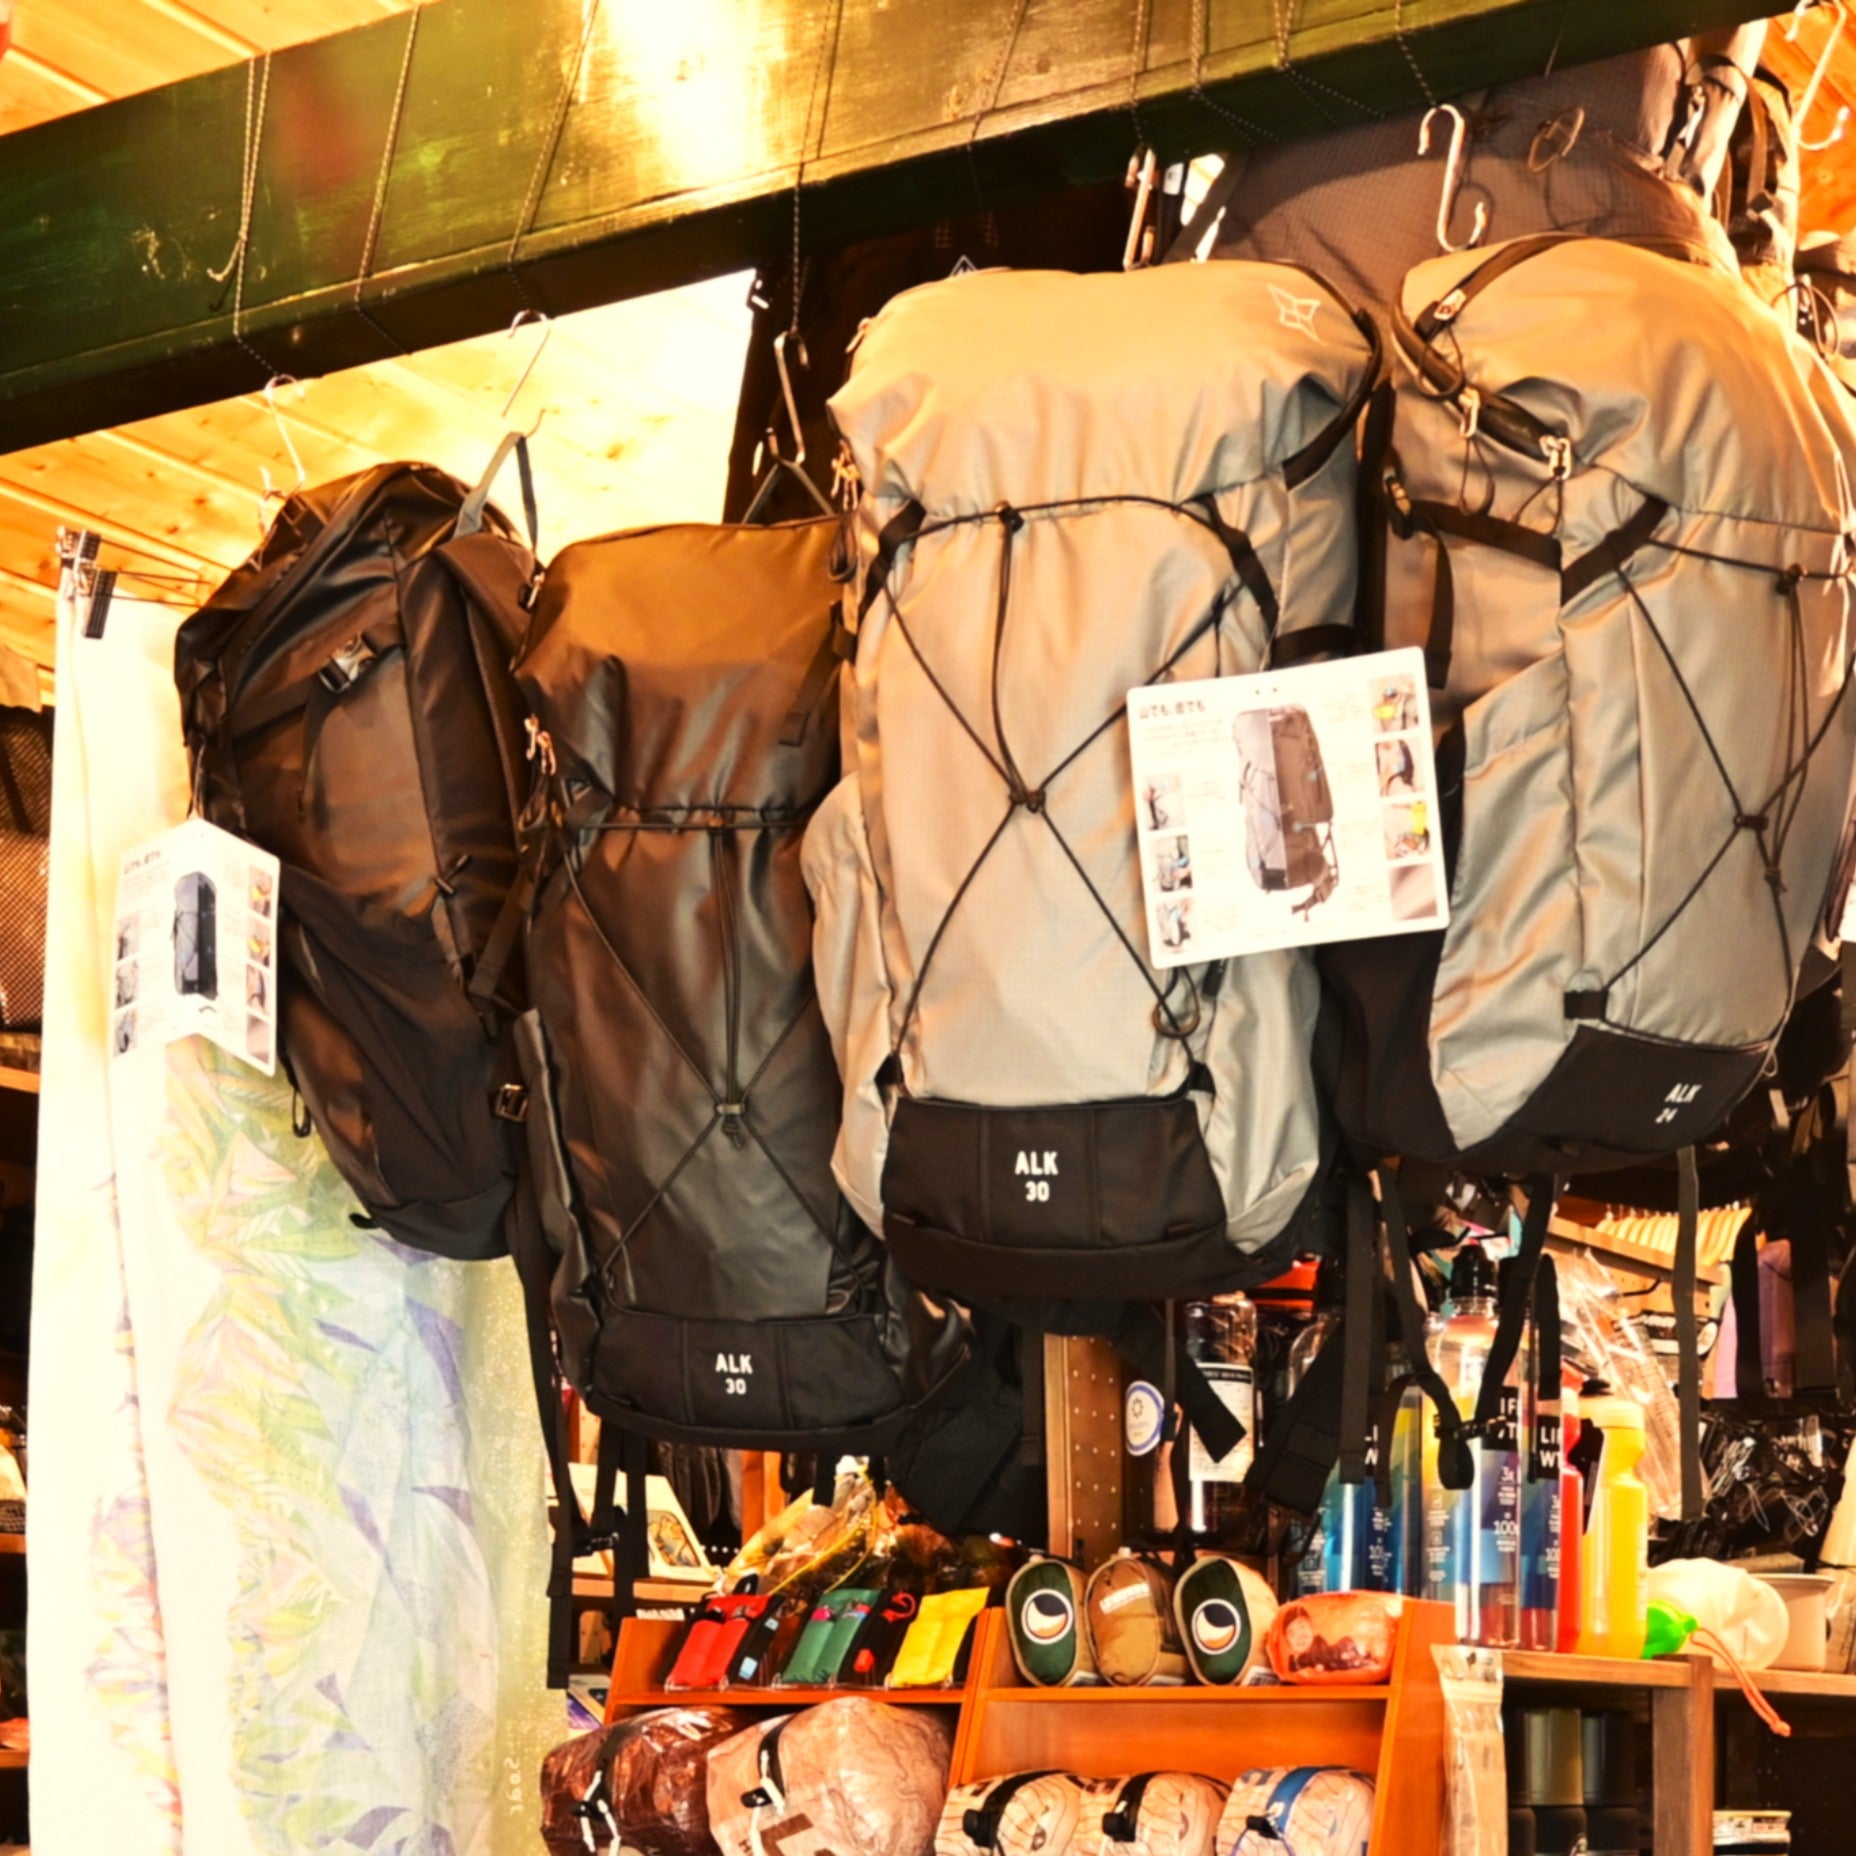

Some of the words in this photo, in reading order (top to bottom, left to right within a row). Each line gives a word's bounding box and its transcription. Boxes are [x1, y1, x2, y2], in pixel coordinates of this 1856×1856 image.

[1665, 1082, 1701, 1104] ALK
[1655, 1107, 1679, 1124] 24
[1014, 1150, 1059, 1177] ALK
[1024, 1181, 1051, 1203] 30
[715, 1353, 753, 1375] ALK
[725, 1378, 747, 1396] 30
